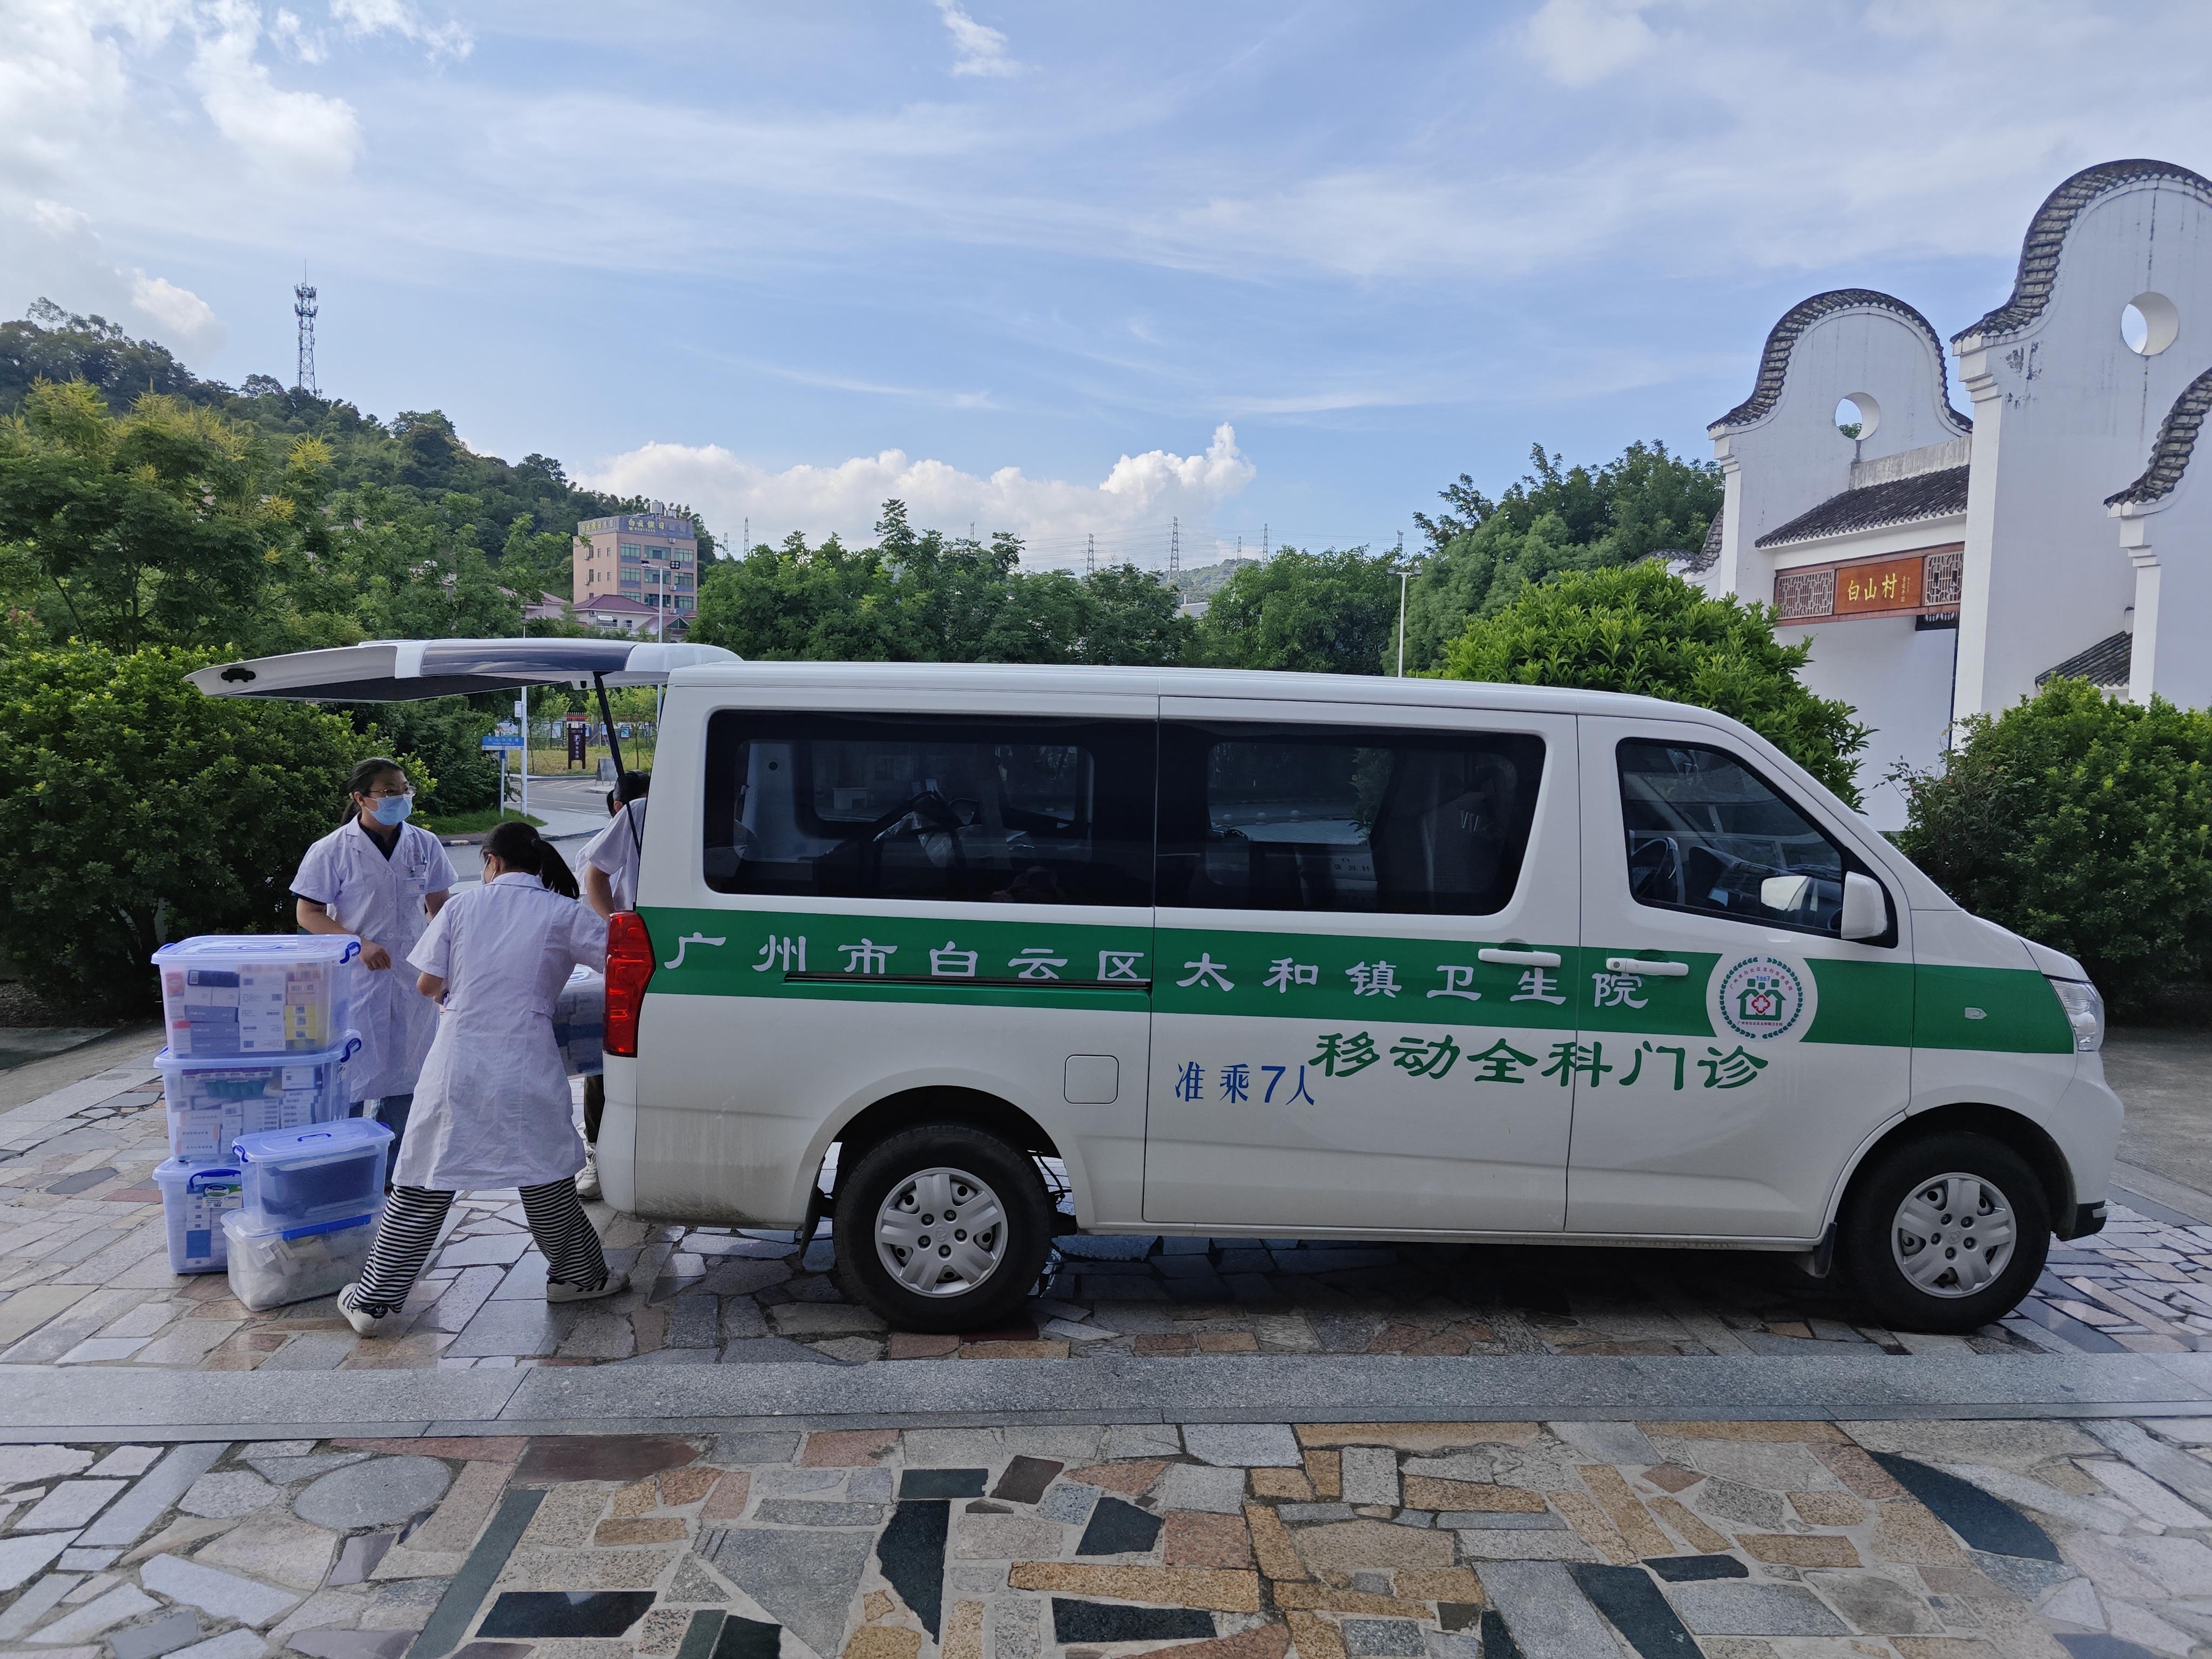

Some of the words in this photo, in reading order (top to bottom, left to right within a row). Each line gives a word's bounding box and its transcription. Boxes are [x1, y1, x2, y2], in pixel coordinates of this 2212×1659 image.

[1847, 572, 1898, 602] 白山村
[664, 932, 1649, 1009] 广州市白云区太和镇卫生院
[1175, 1061, 1314, 1105] 准乘7人
[1309, 1031, 1769, 1091] 移动全科门诊
